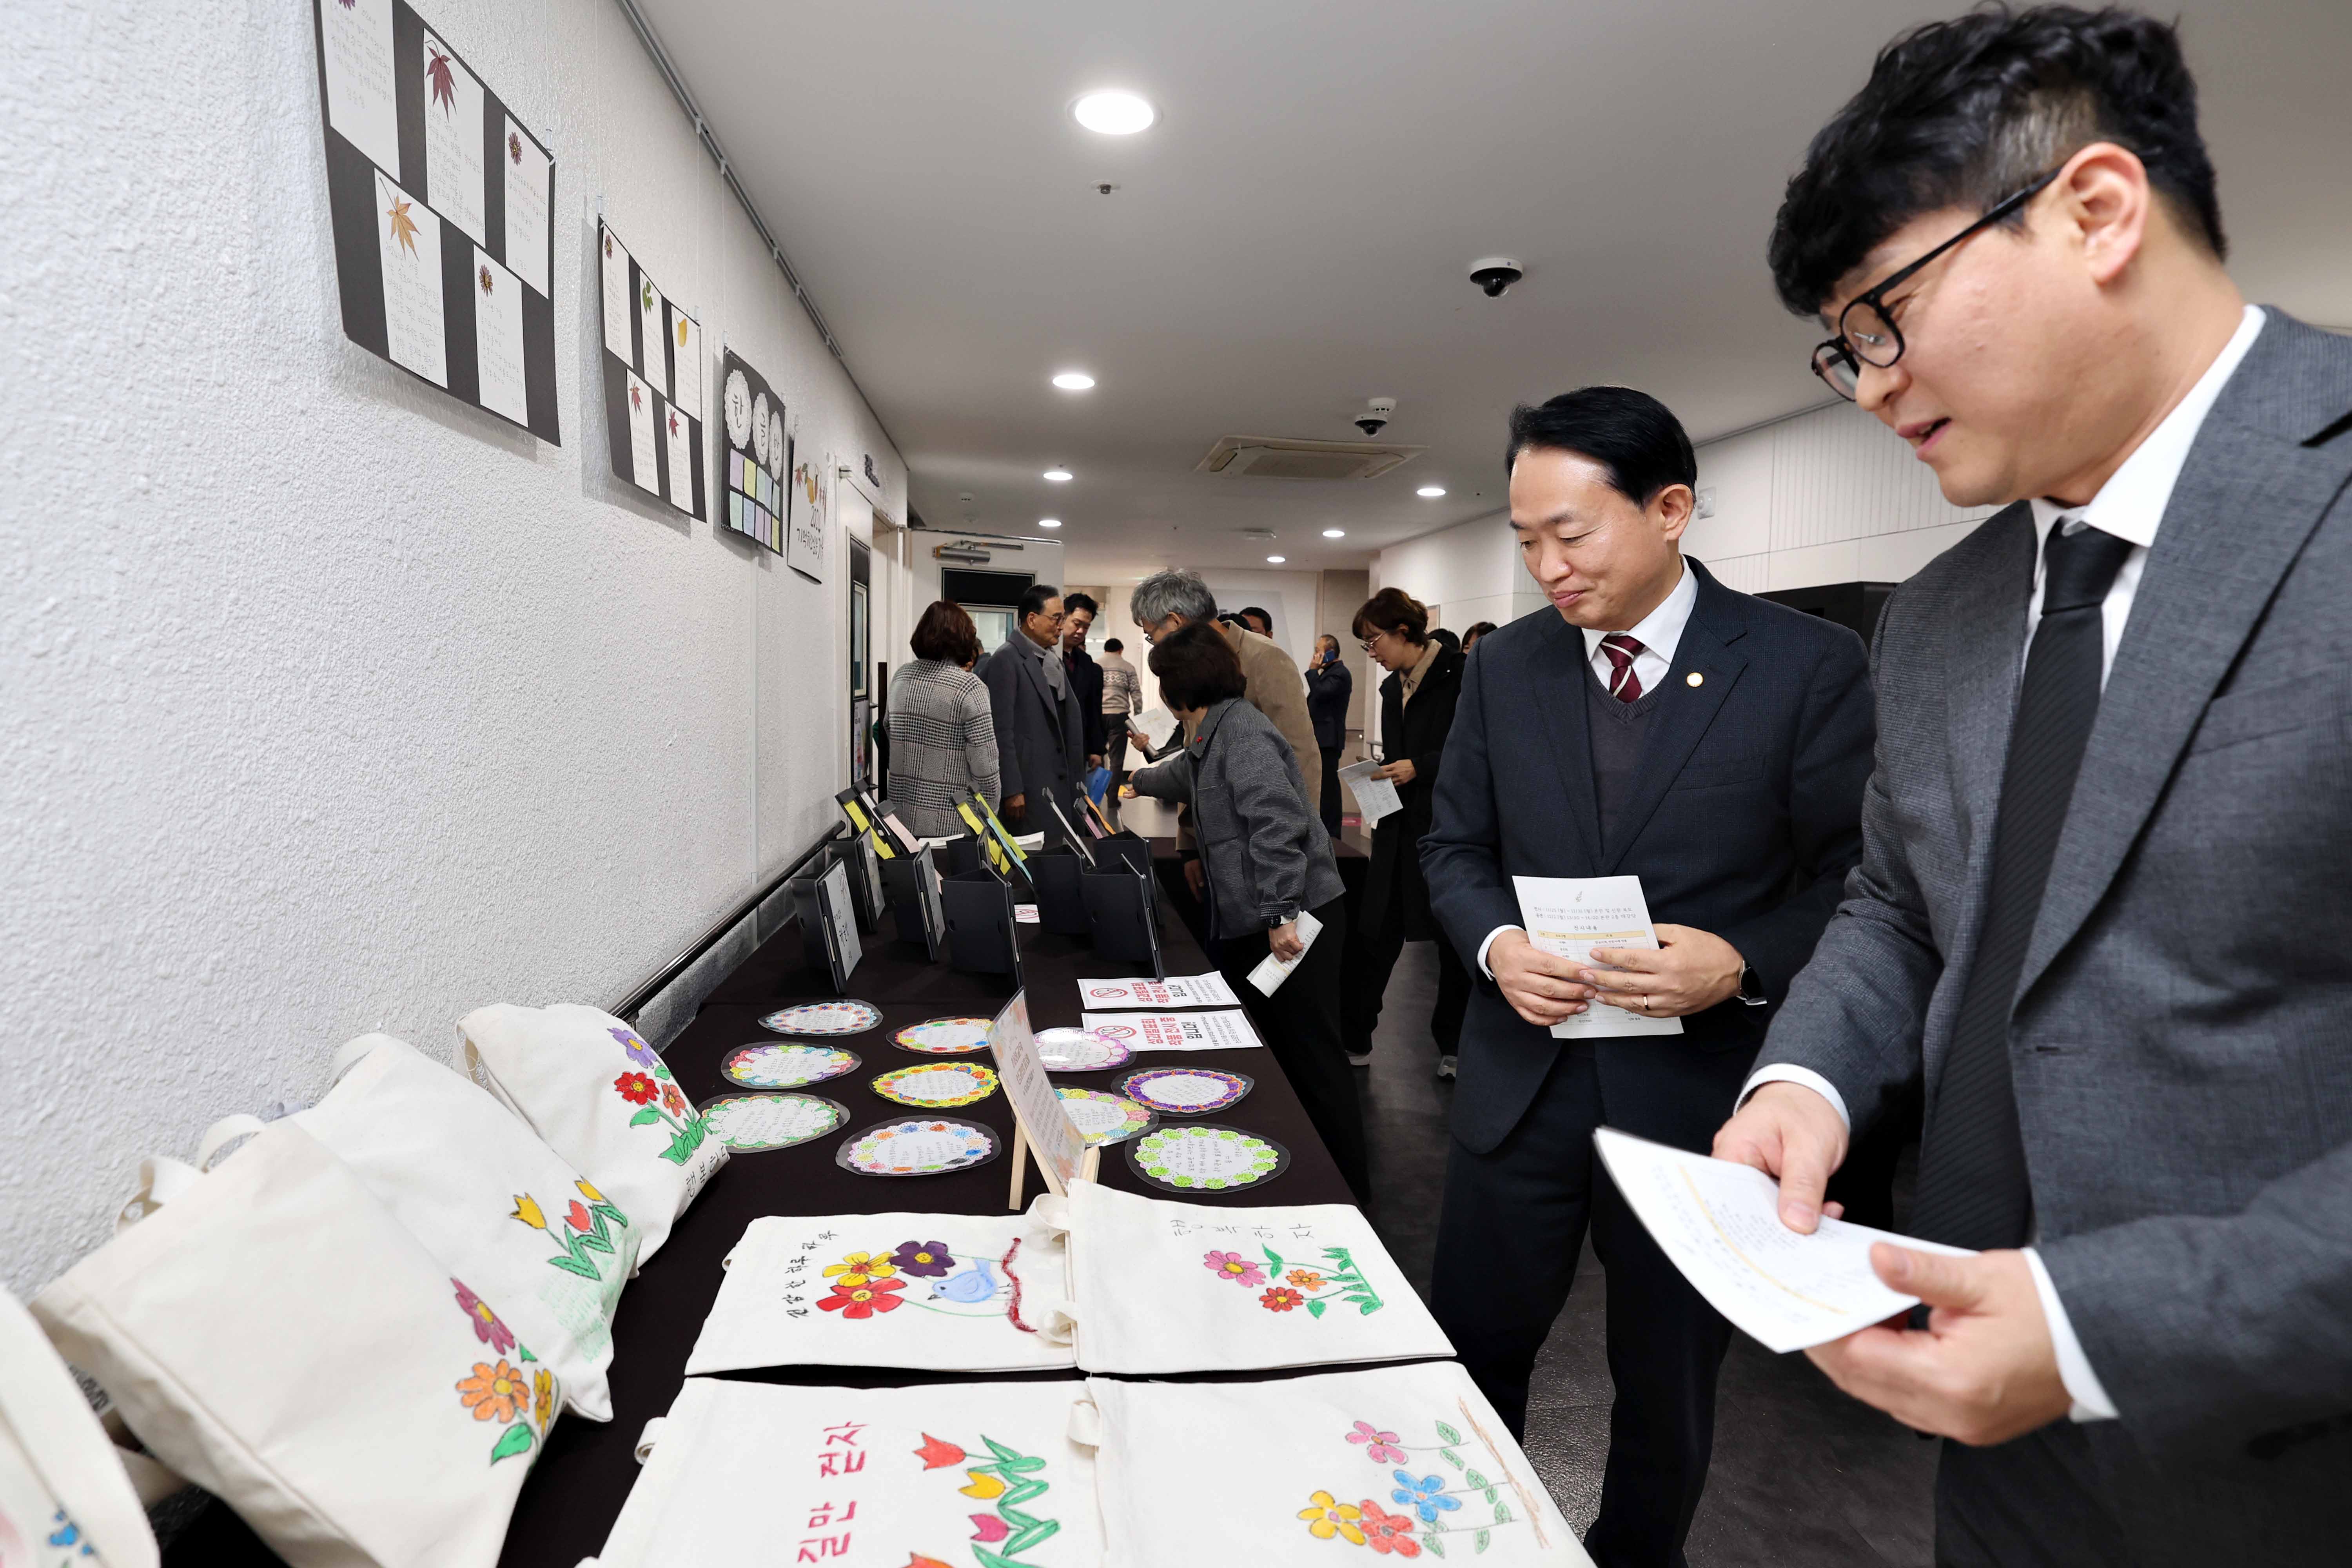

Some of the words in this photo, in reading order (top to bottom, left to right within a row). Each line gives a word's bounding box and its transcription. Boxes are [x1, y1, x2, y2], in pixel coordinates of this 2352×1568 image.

[1131, 983, 1152, 1002] 성과발표회
[1155, 994, 1170, 1003] 작품
[1168, 985, 1187, 997] 입니다!
[1141, 1019, 1163, 1044] 성과발표회
[1162, 1024, 1180, 1033] 전시
[1181, 1022, 1202, 1038] 입니다!
[1166, 1035, 1183, 1045] 작품
[817, 1421, 868, 1478] 걷자
[797, 1501, 857, 1564] 길만
